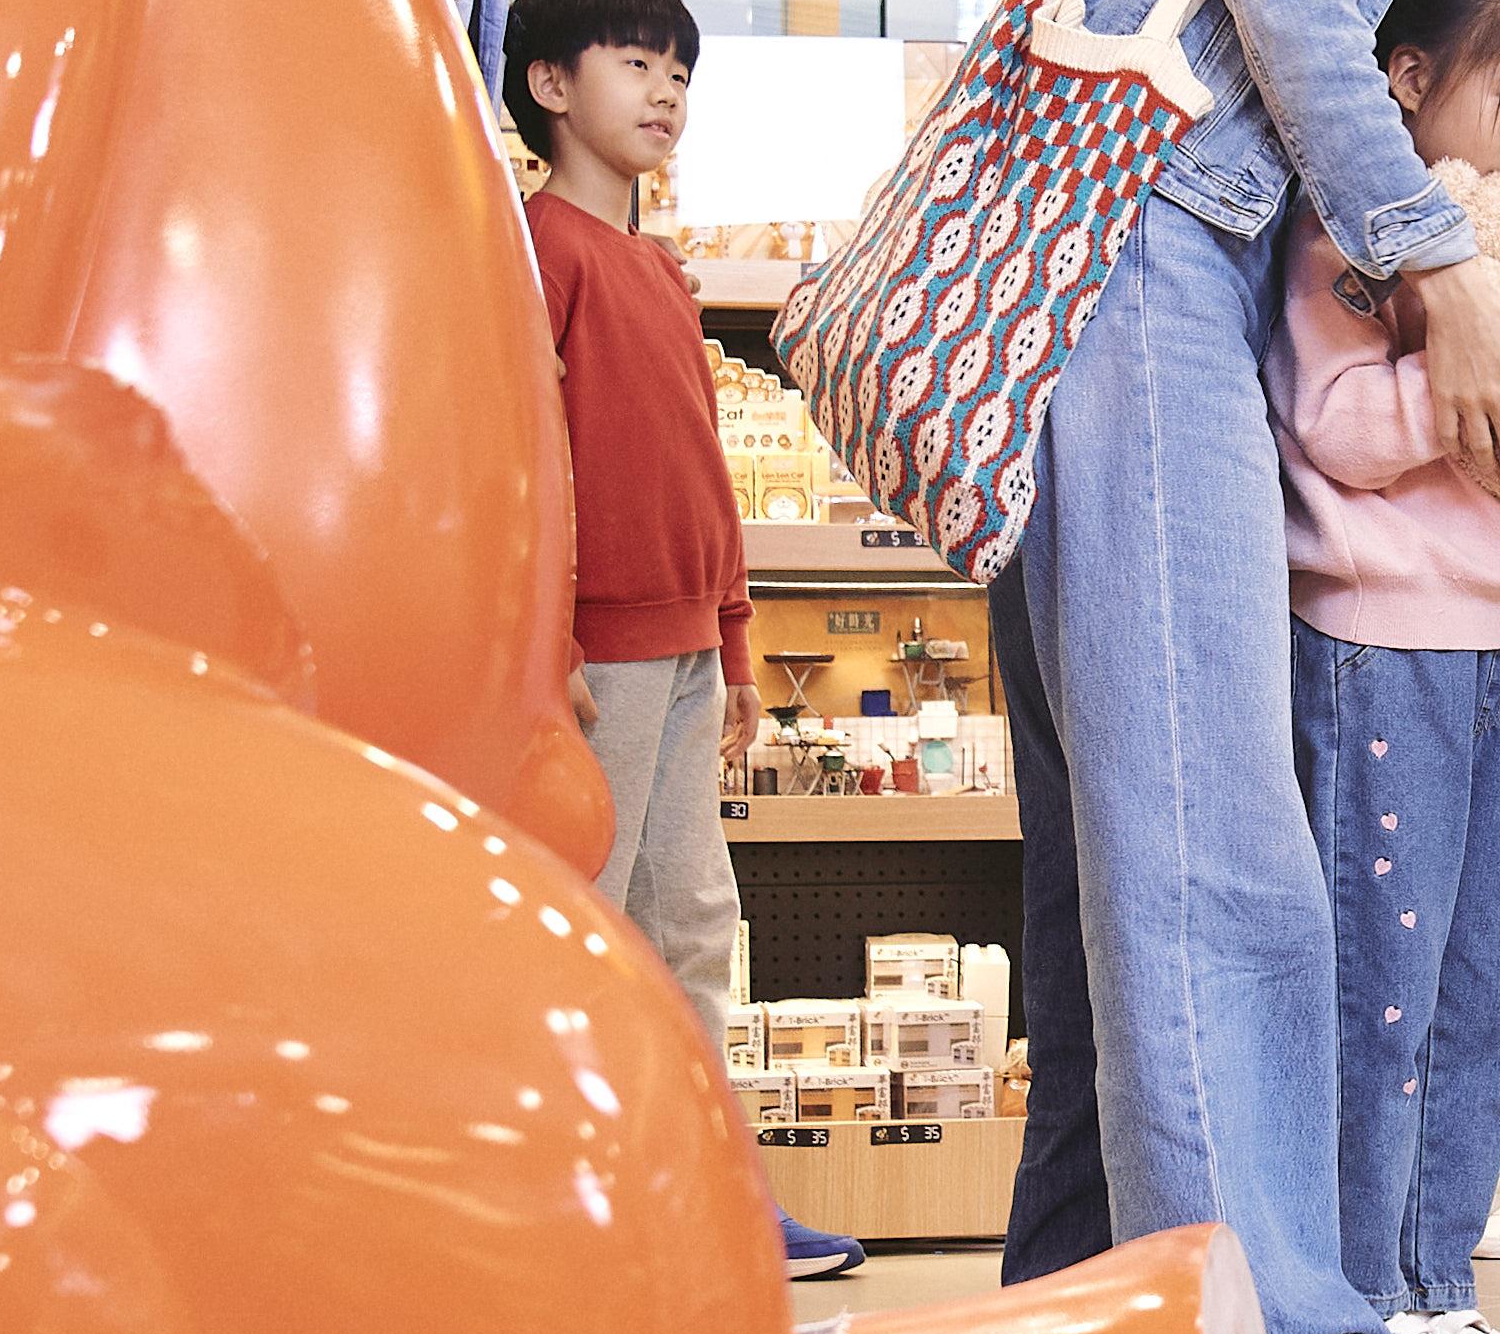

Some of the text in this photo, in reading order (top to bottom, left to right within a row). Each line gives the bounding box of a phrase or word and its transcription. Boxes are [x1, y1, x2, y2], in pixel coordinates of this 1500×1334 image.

[717, 407, 744, 421] Cat
[731, 804, 746, 817] 30
[786, 1129, 828, 1145] $ 35
[900, 1126, 940, 1141] $ 35
